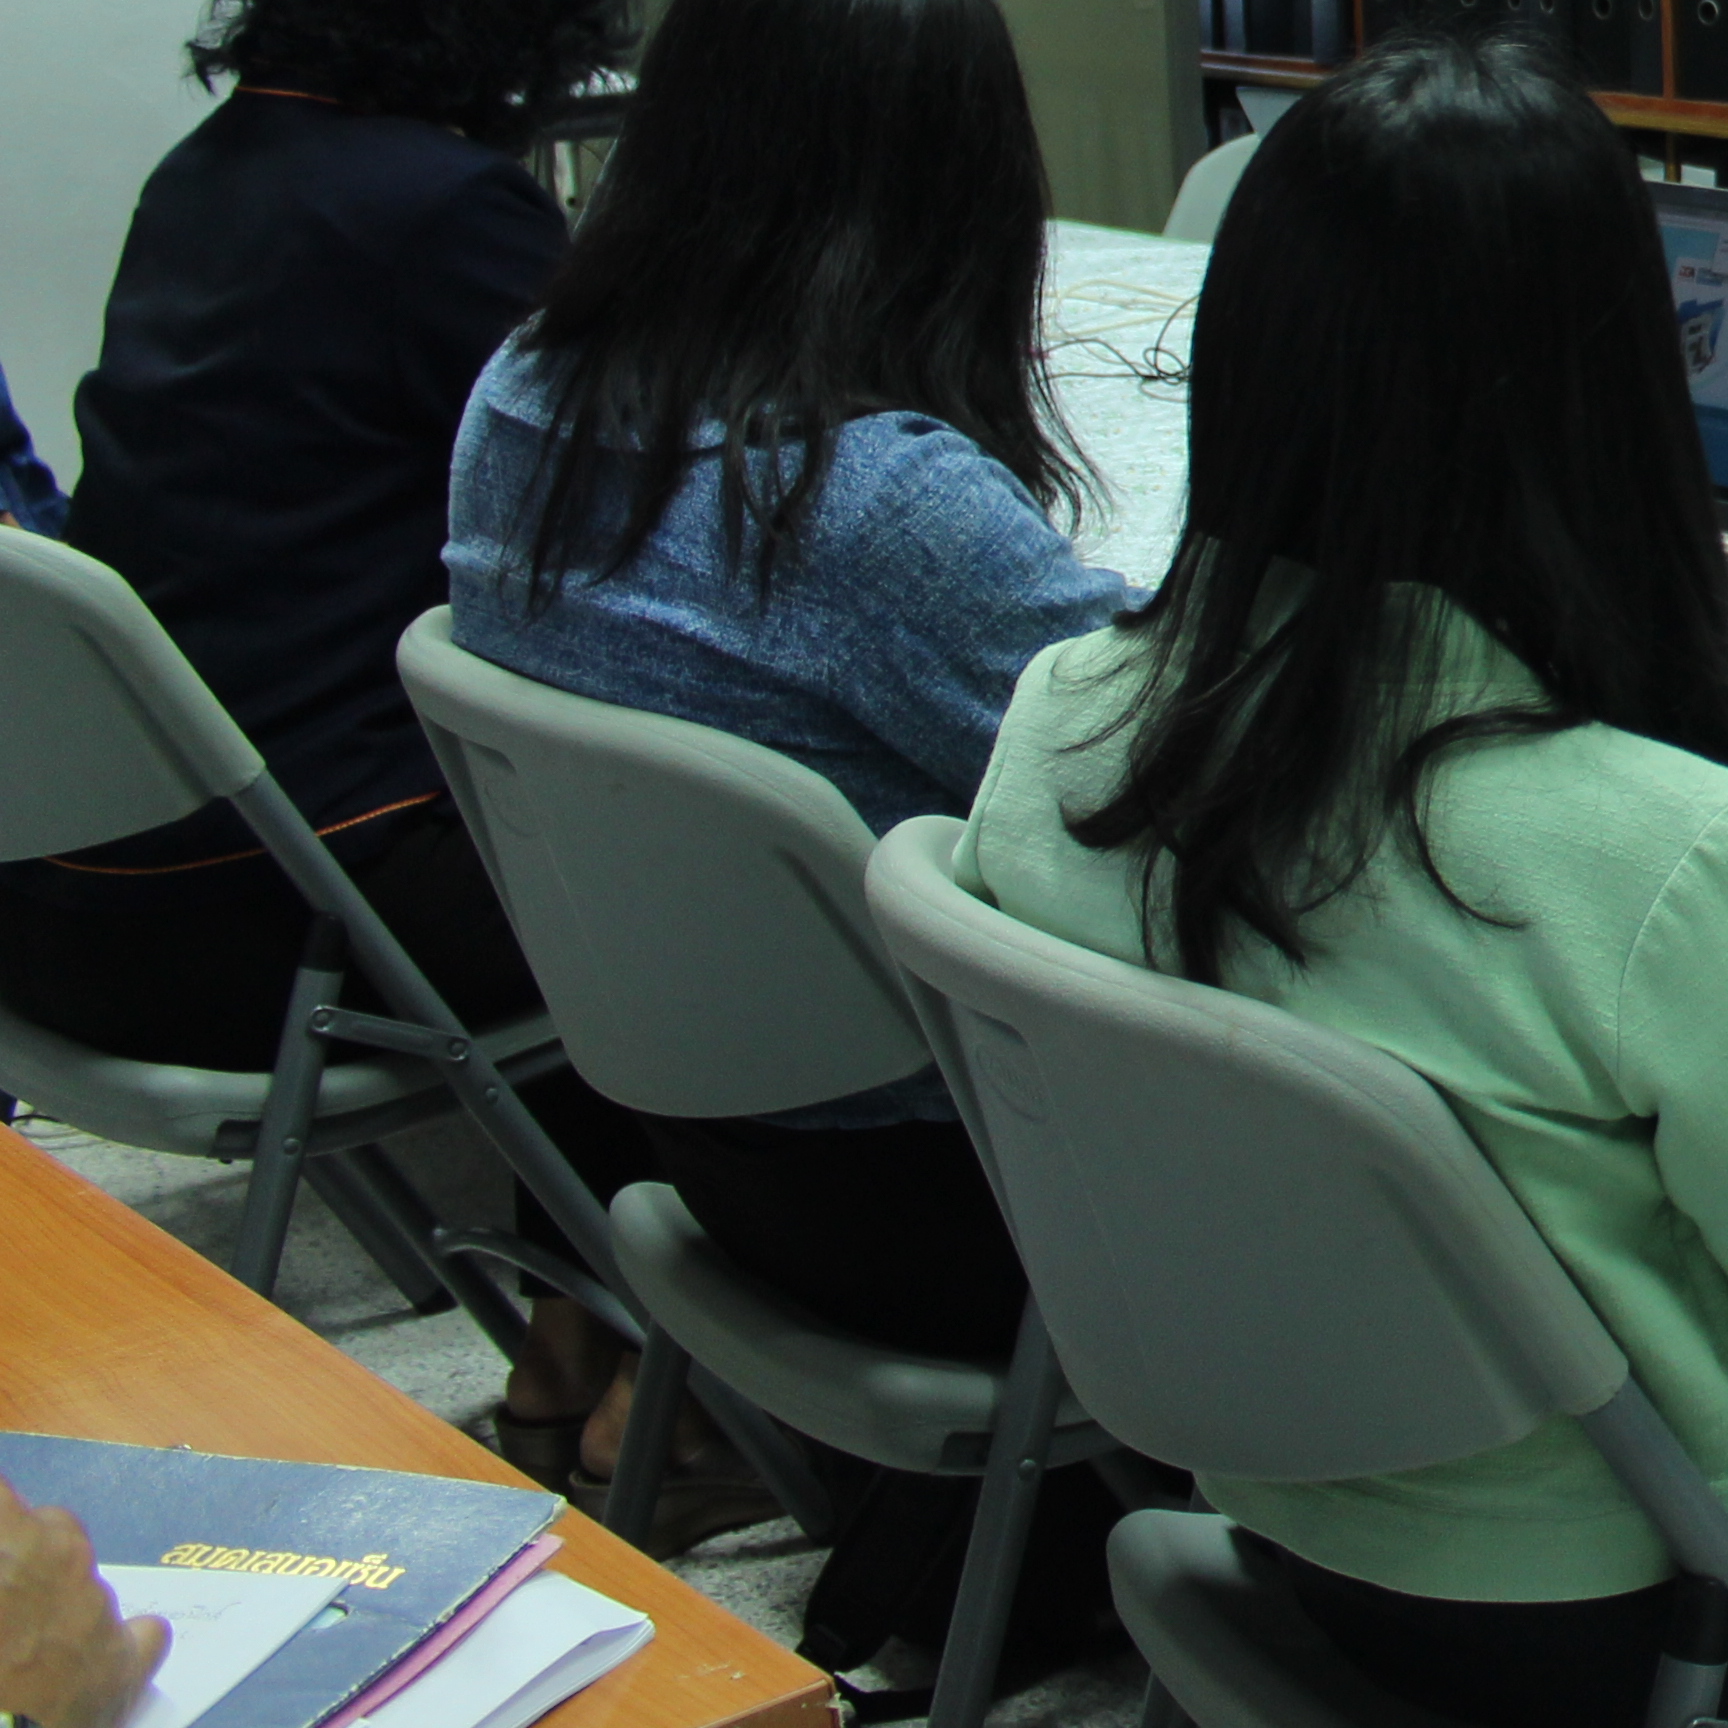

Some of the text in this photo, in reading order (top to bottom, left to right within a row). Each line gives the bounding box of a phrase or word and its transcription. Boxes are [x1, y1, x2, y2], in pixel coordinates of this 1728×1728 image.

[160, 1541, 406, 1589] สมดเสนอเซ็น
